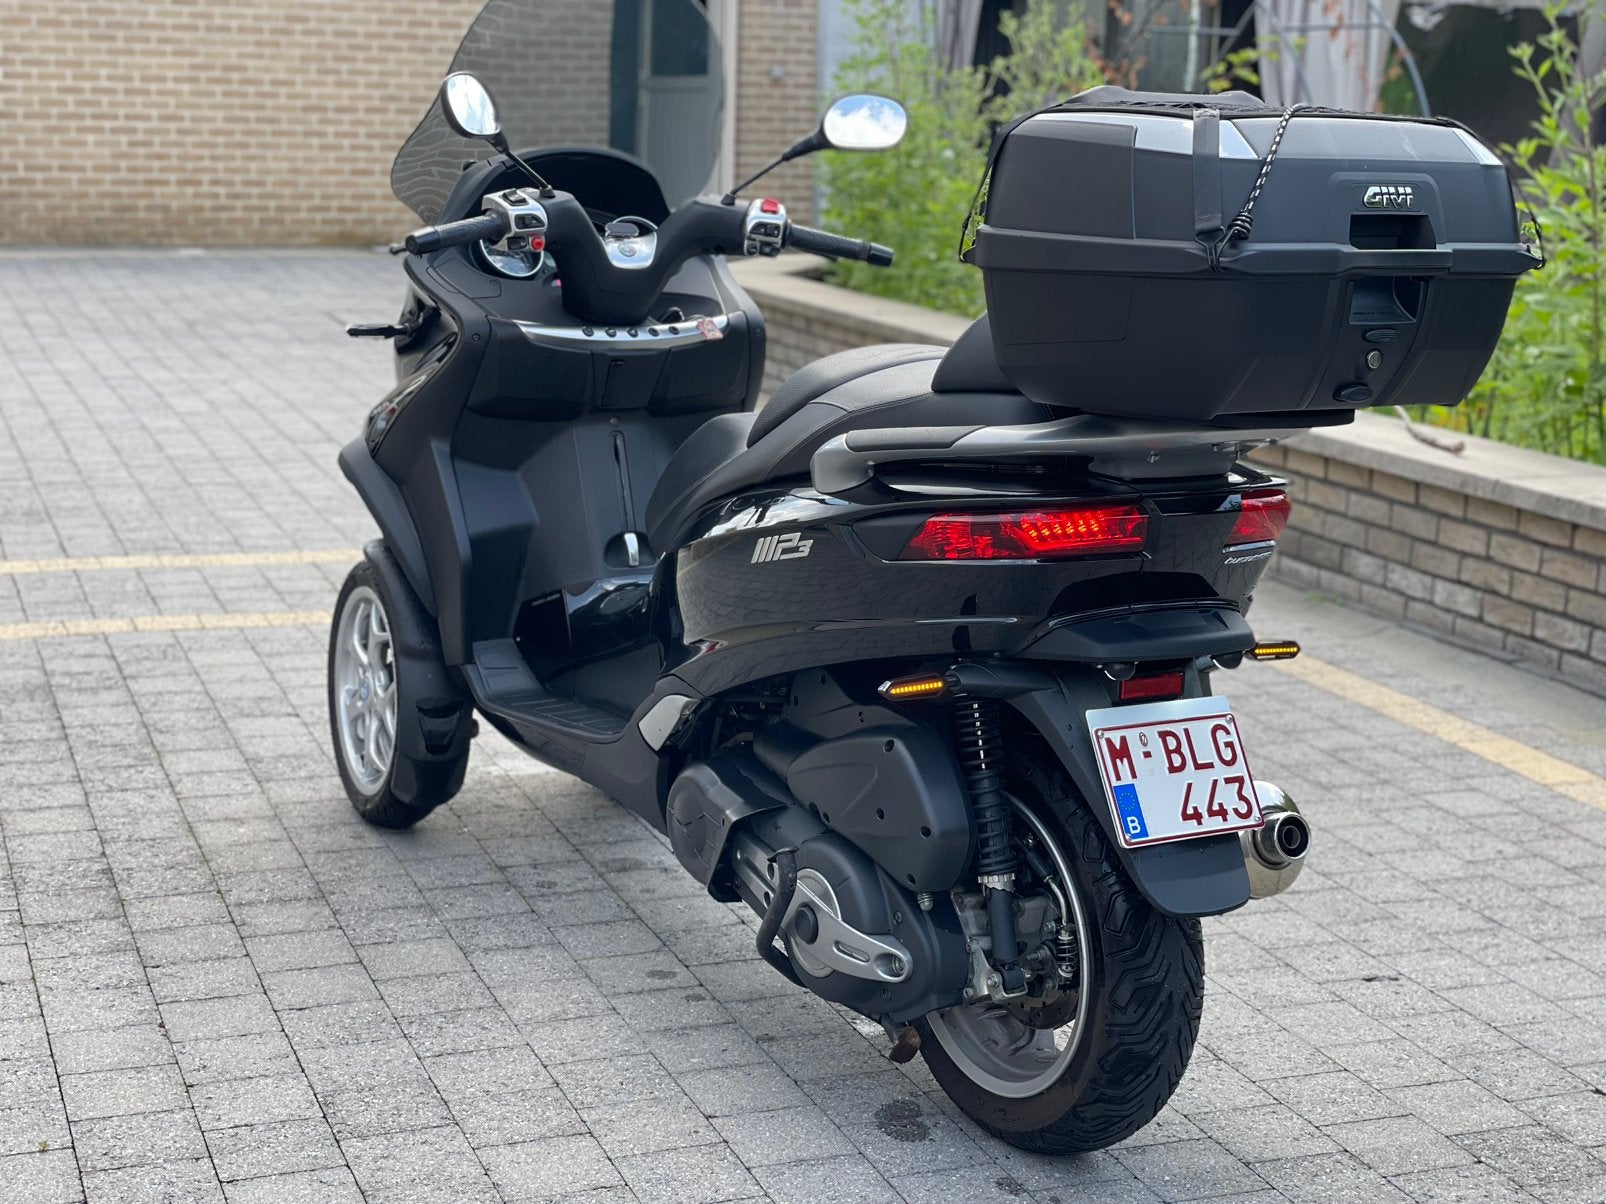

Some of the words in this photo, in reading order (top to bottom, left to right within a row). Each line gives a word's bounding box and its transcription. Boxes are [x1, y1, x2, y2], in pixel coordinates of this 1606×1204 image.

[1363, 186, 1414, 208] GIVI
[750, 532, 814, 564] MP3
[1180, 775, 1253, 826] 443
[1126, 816, 1141, 834] B
